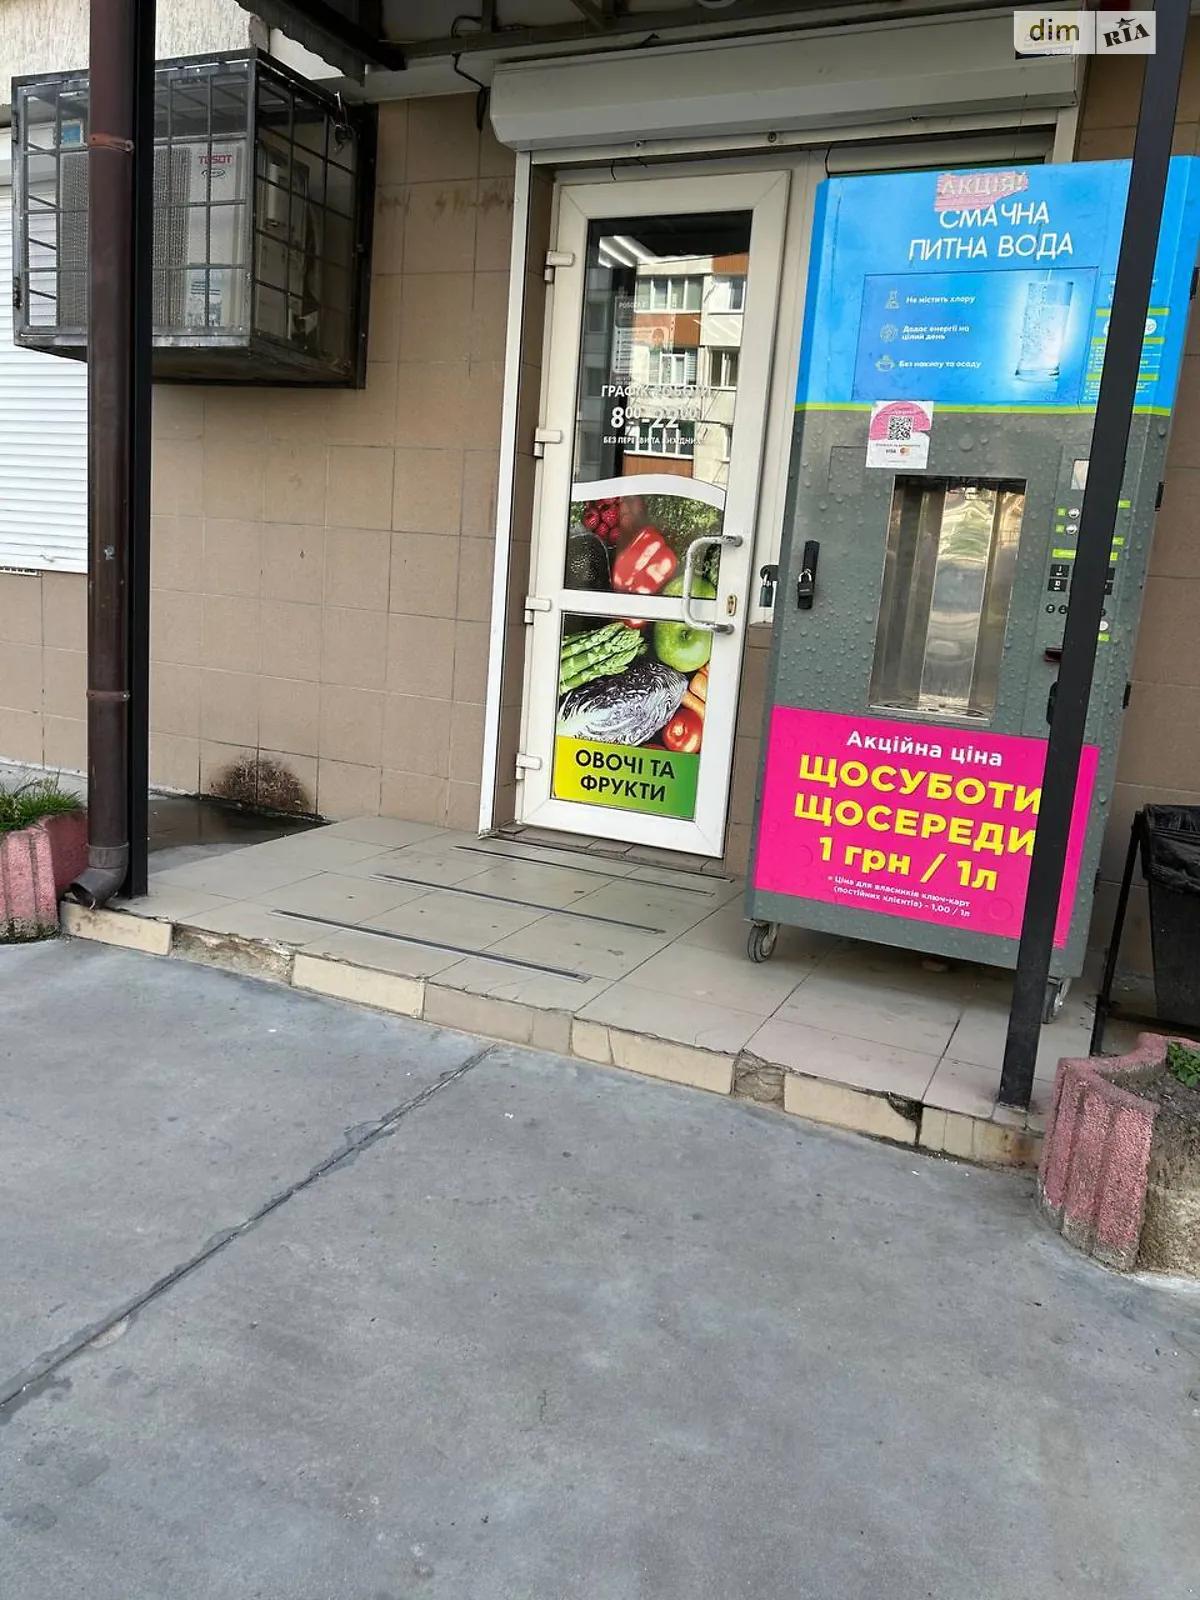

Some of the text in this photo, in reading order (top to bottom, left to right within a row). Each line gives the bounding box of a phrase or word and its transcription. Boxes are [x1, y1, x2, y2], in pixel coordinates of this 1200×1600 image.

[942, 172, 1025, 194] АКЦІЯ!
[939, 200, 1050, 229] СМАЧНА
[908, 232, 1073, 261] ПИТНА ВОДА
[950, 296, 976, 304] хлору
[846, 730, 1003, 767] Акційна ціна
[575, 749, 675, 779] ОВОЧІ ТА
[580, 774, 666, 802] ФРУКТИ
[799, 754, 1042, 814] ЩОСУБОТИ
[794, 793, 1036, 855] ЩОСЕРЕДИ
[819, 837, 998, 891] 1 грн / 1л
[833, 885, 881, 900] (постійних
[883, 895, 923, 909] клієнтів)
[931, 903, 951, 914] 1,00
[855, 881, 873, 889] для
[874, 884, 920, 898] власників
[921, 893, 970, 907] ключ-карт
